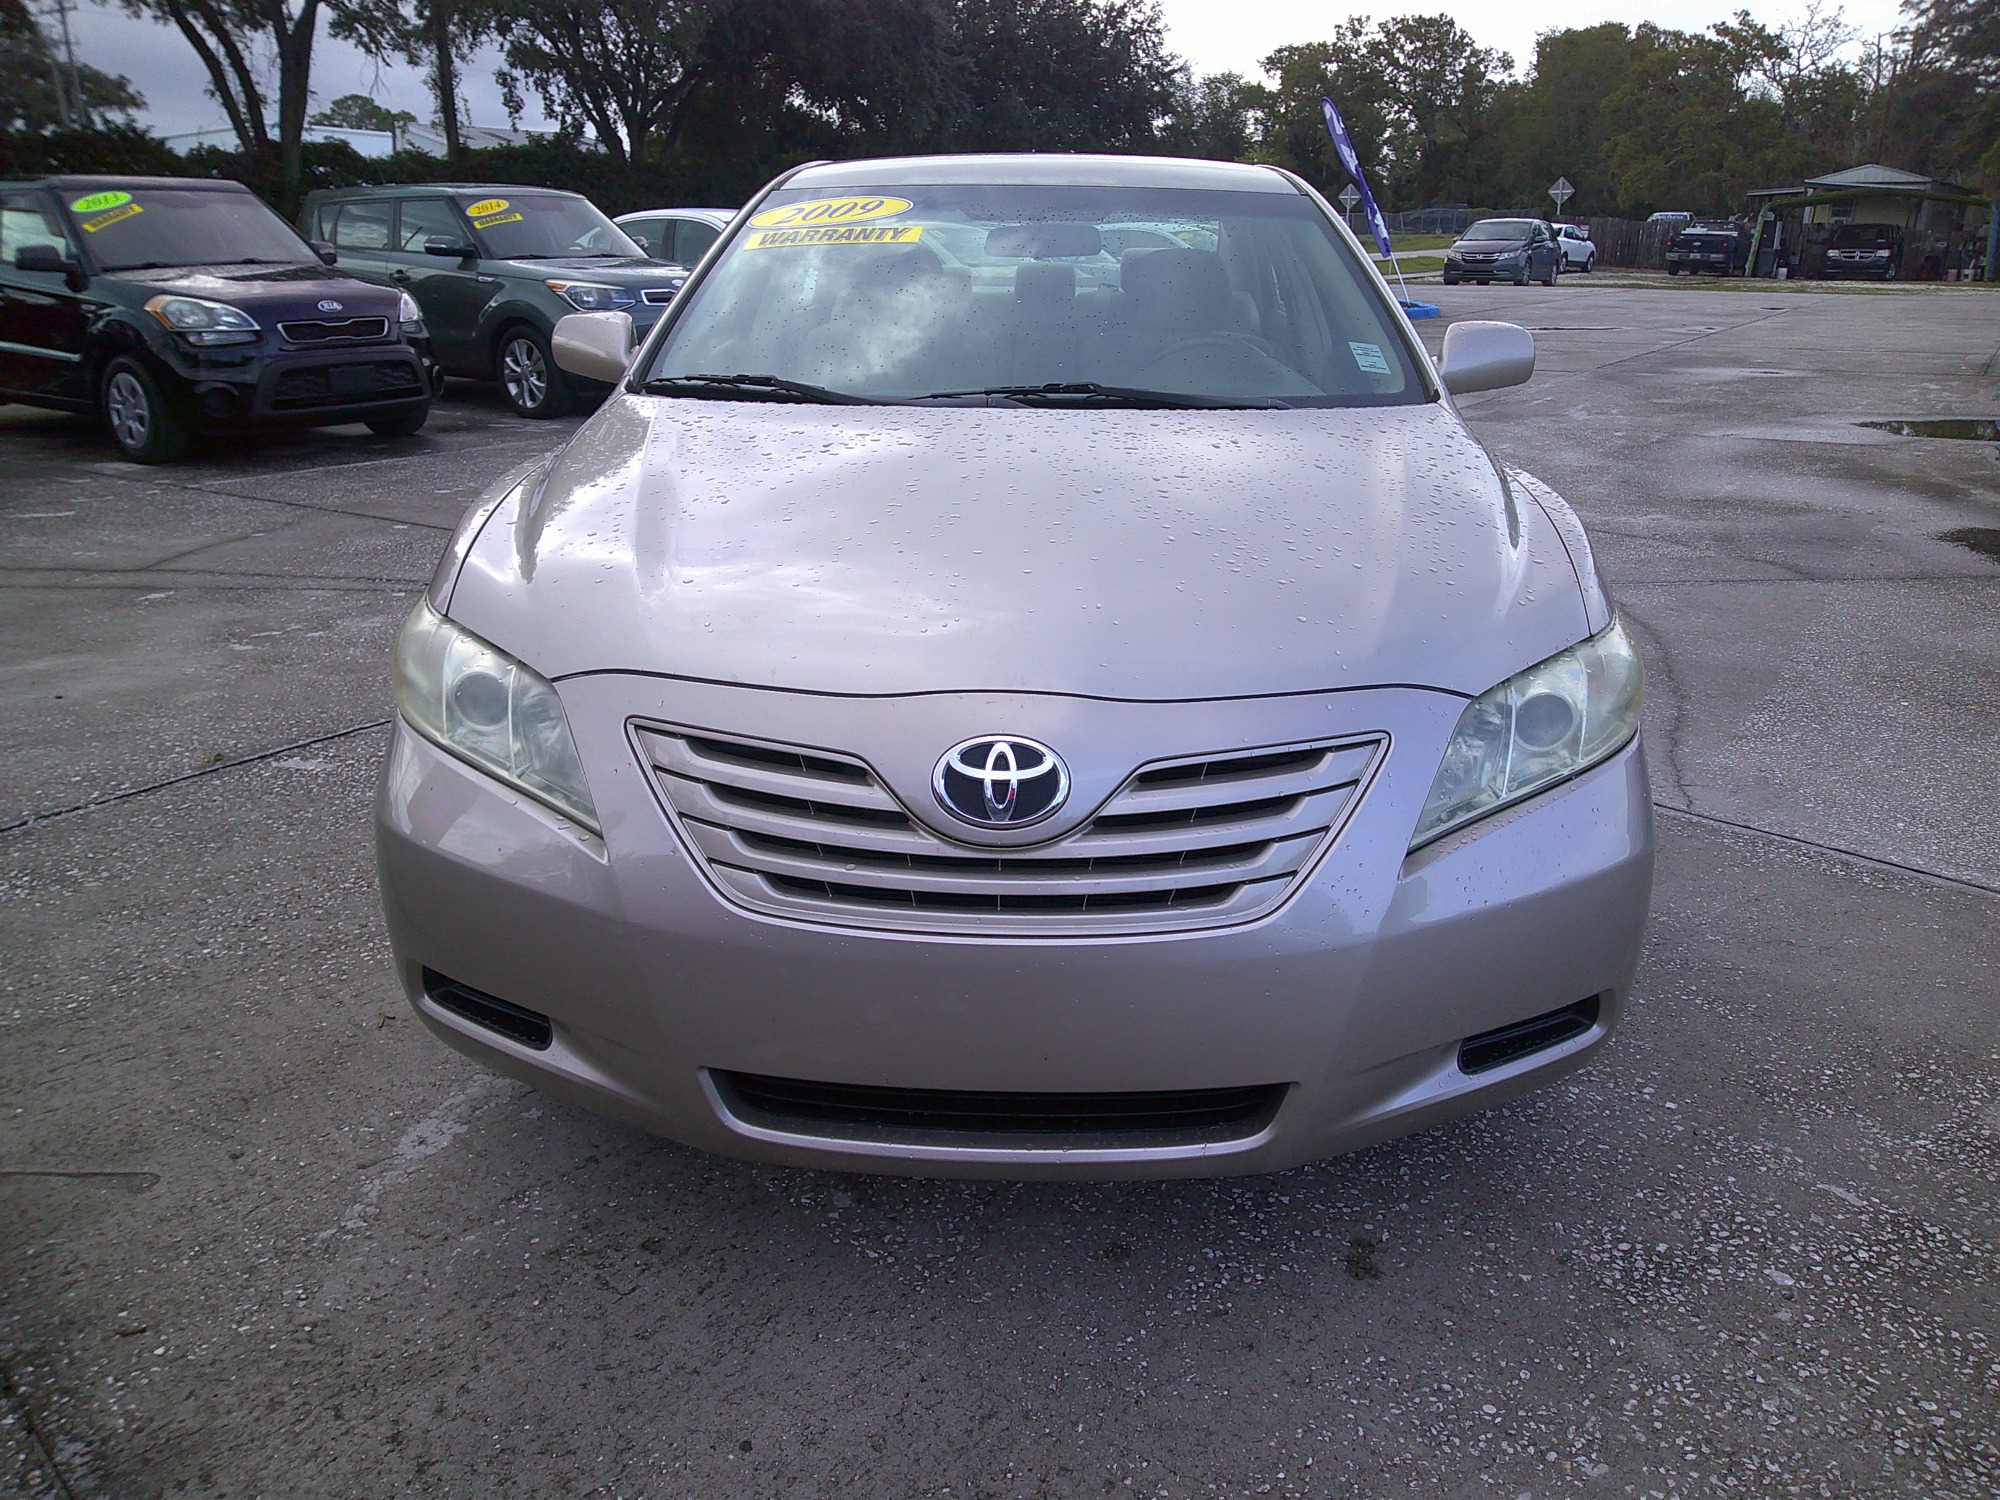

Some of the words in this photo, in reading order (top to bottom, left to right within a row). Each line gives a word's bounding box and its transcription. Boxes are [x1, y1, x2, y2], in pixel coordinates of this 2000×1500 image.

[475, 200, 502, 214] 2014
[771, 200, 885, 226] 2009
[758, 227, 913, 247] WARRANTY
